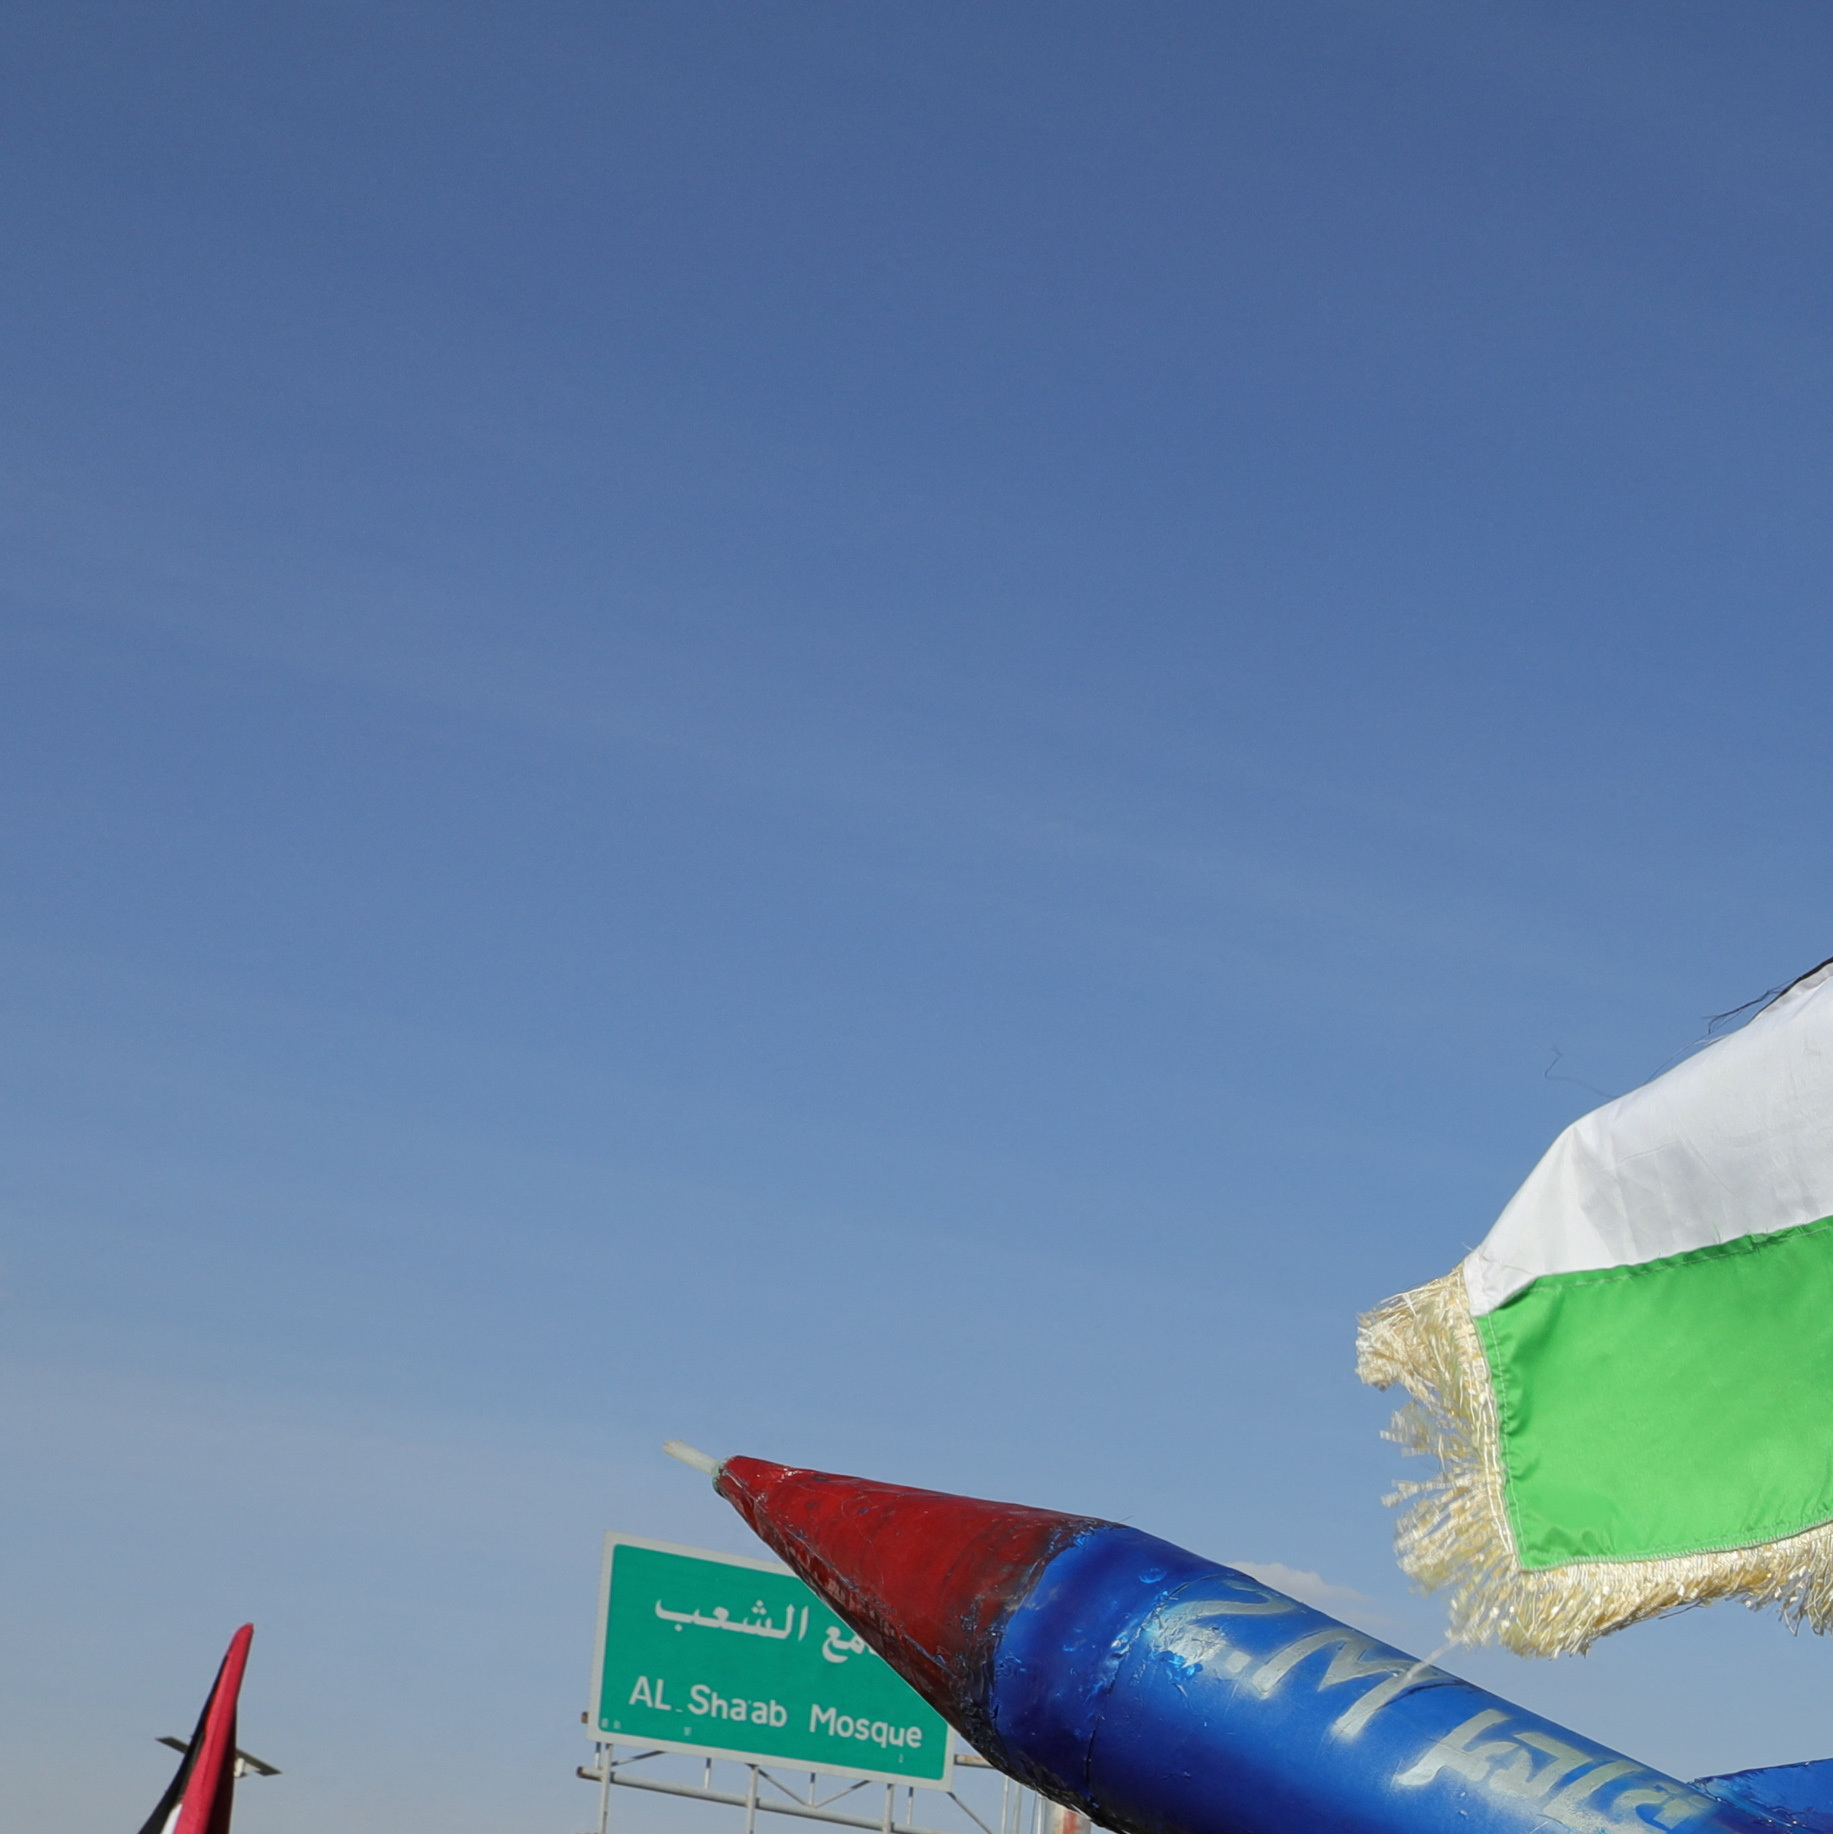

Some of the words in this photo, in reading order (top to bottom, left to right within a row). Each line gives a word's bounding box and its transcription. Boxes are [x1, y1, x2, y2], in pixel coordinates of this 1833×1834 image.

[654, 1599, 809, 1642] الشعب
[821, 1625, 879, 1663] مع
[809, 1703, 923, 1749] Mosque
